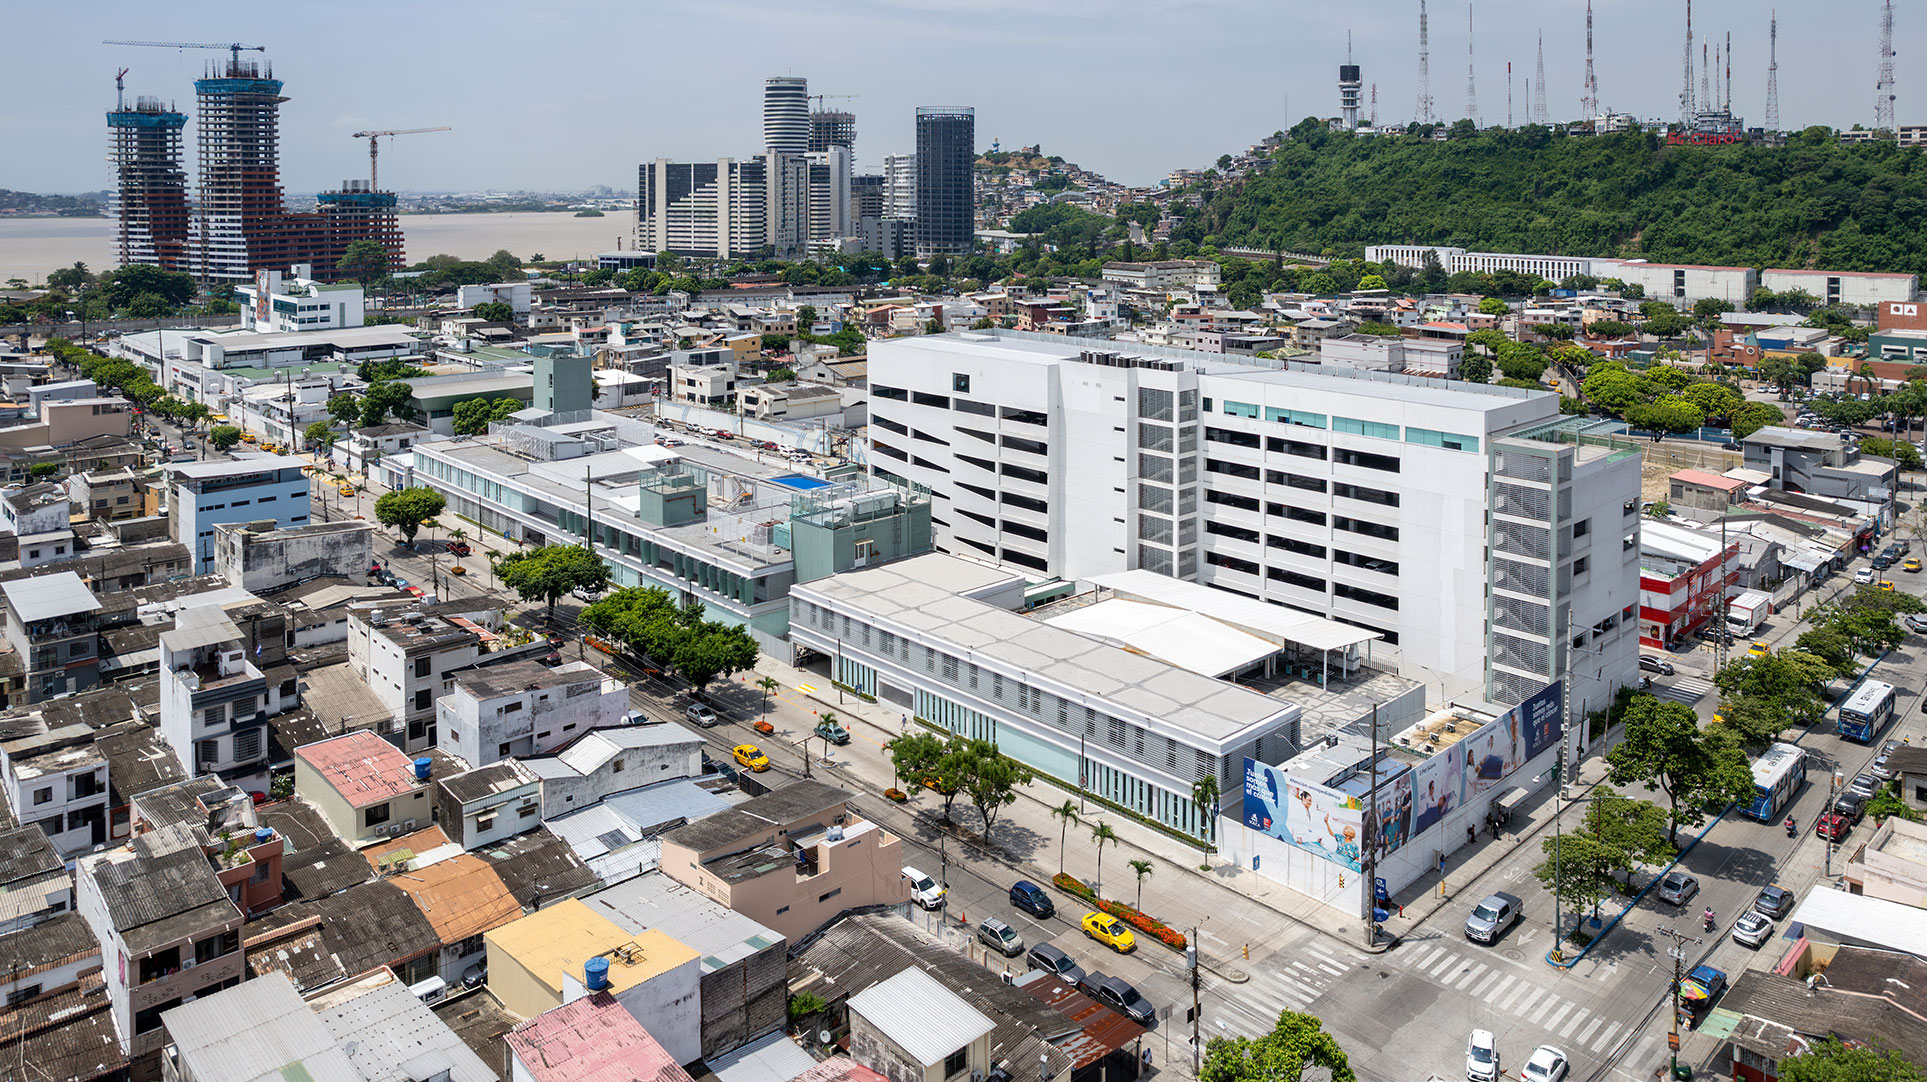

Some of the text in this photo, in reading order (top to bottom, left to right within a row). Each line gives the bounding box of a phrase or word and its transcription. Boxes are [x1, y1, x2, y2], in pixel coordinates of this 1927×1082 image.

[1667, 132, 1735, 145] 5G Claro
[1533, 699, 1546, 711] Juntos
[1533, 707, 1545, 719] somos
[1532, 717, 1540, 728] que
[1246, 768, 1268, 783] Juntos
[1246, 776, 1268, 788] somos
[1246, 788, 1252, 796] el
[1261, 788, 1274, 798] que
